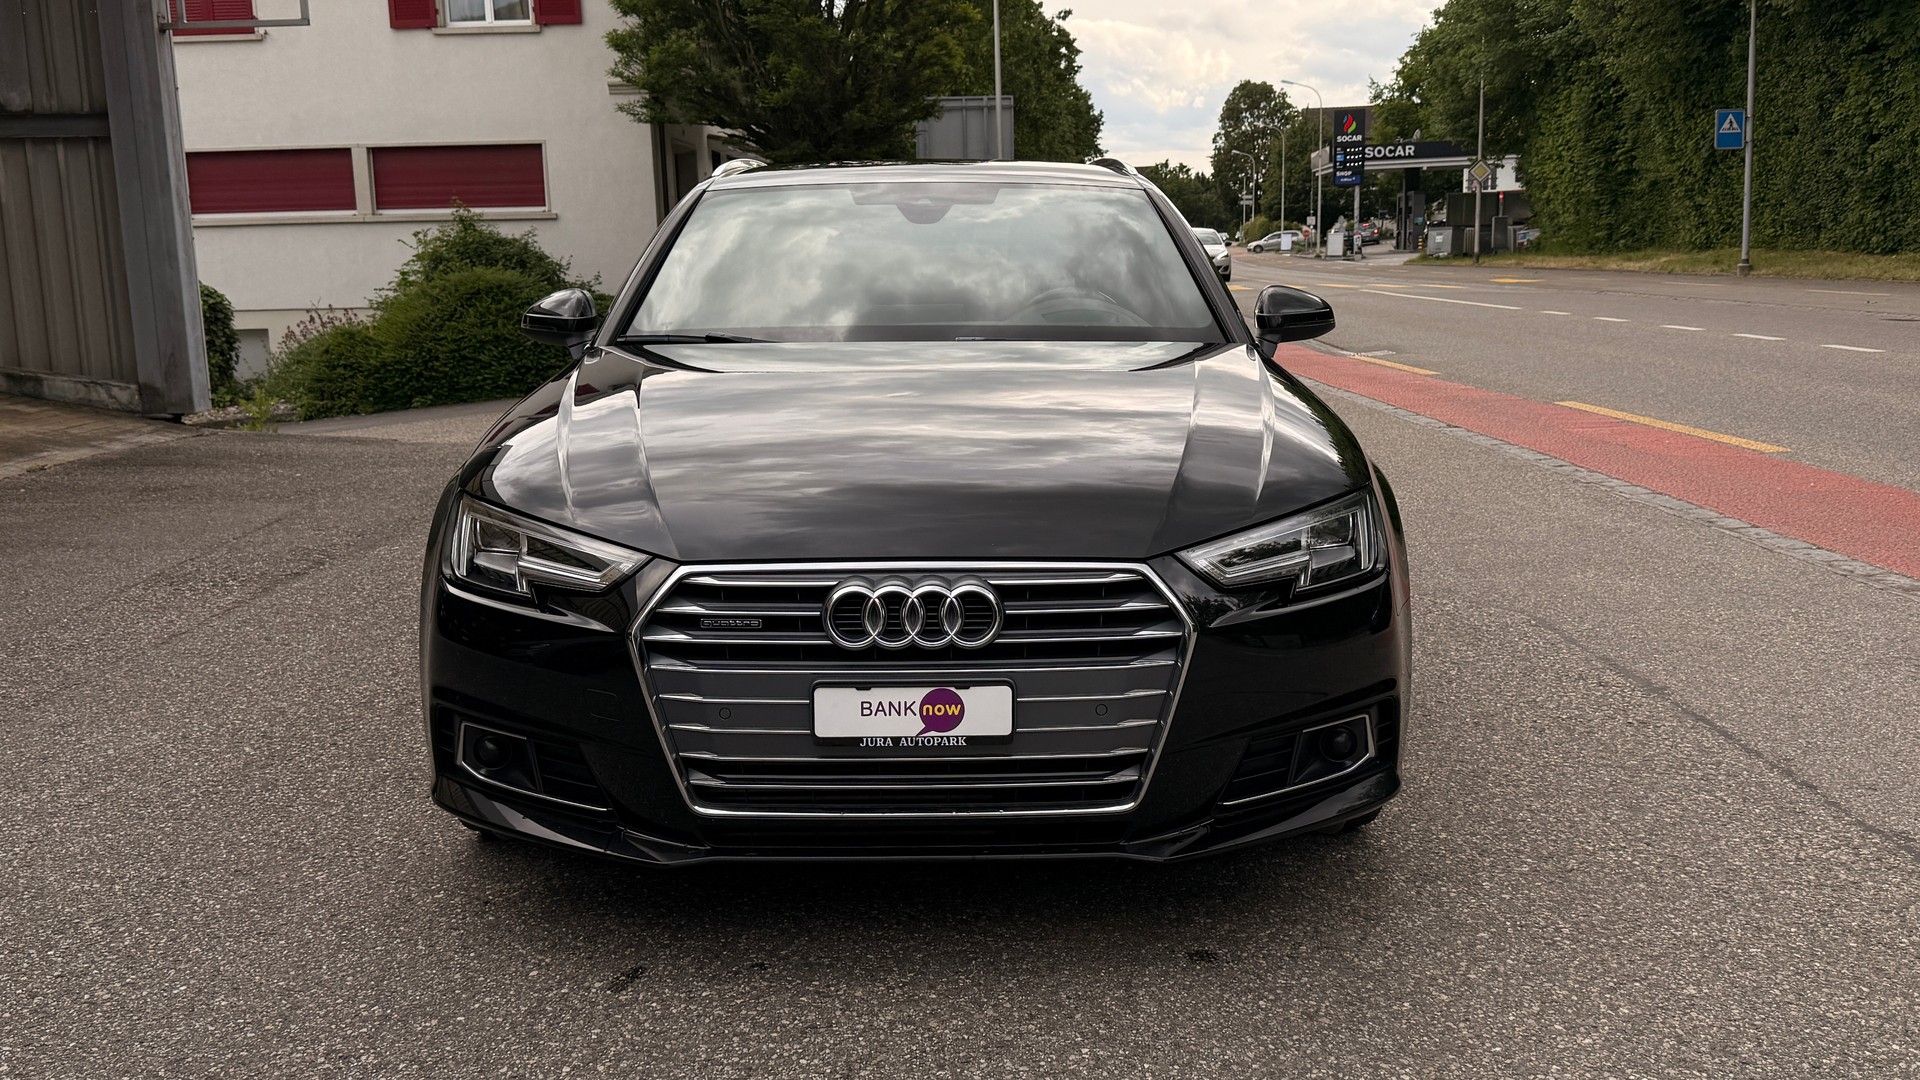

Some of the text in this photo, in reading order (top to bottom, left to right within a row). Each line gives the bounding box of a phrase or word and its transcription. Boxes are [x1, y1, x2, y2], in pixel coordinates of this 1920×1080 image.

[1336, 135, 1362, 143] SOCAR
[1365, 145, 1415, 158] SOCAR
[703, 620, 759, 628] quattro
[860, 700, 961, 717] BANK now
[860, 736, 967, 747] JURA AUTOPARK
